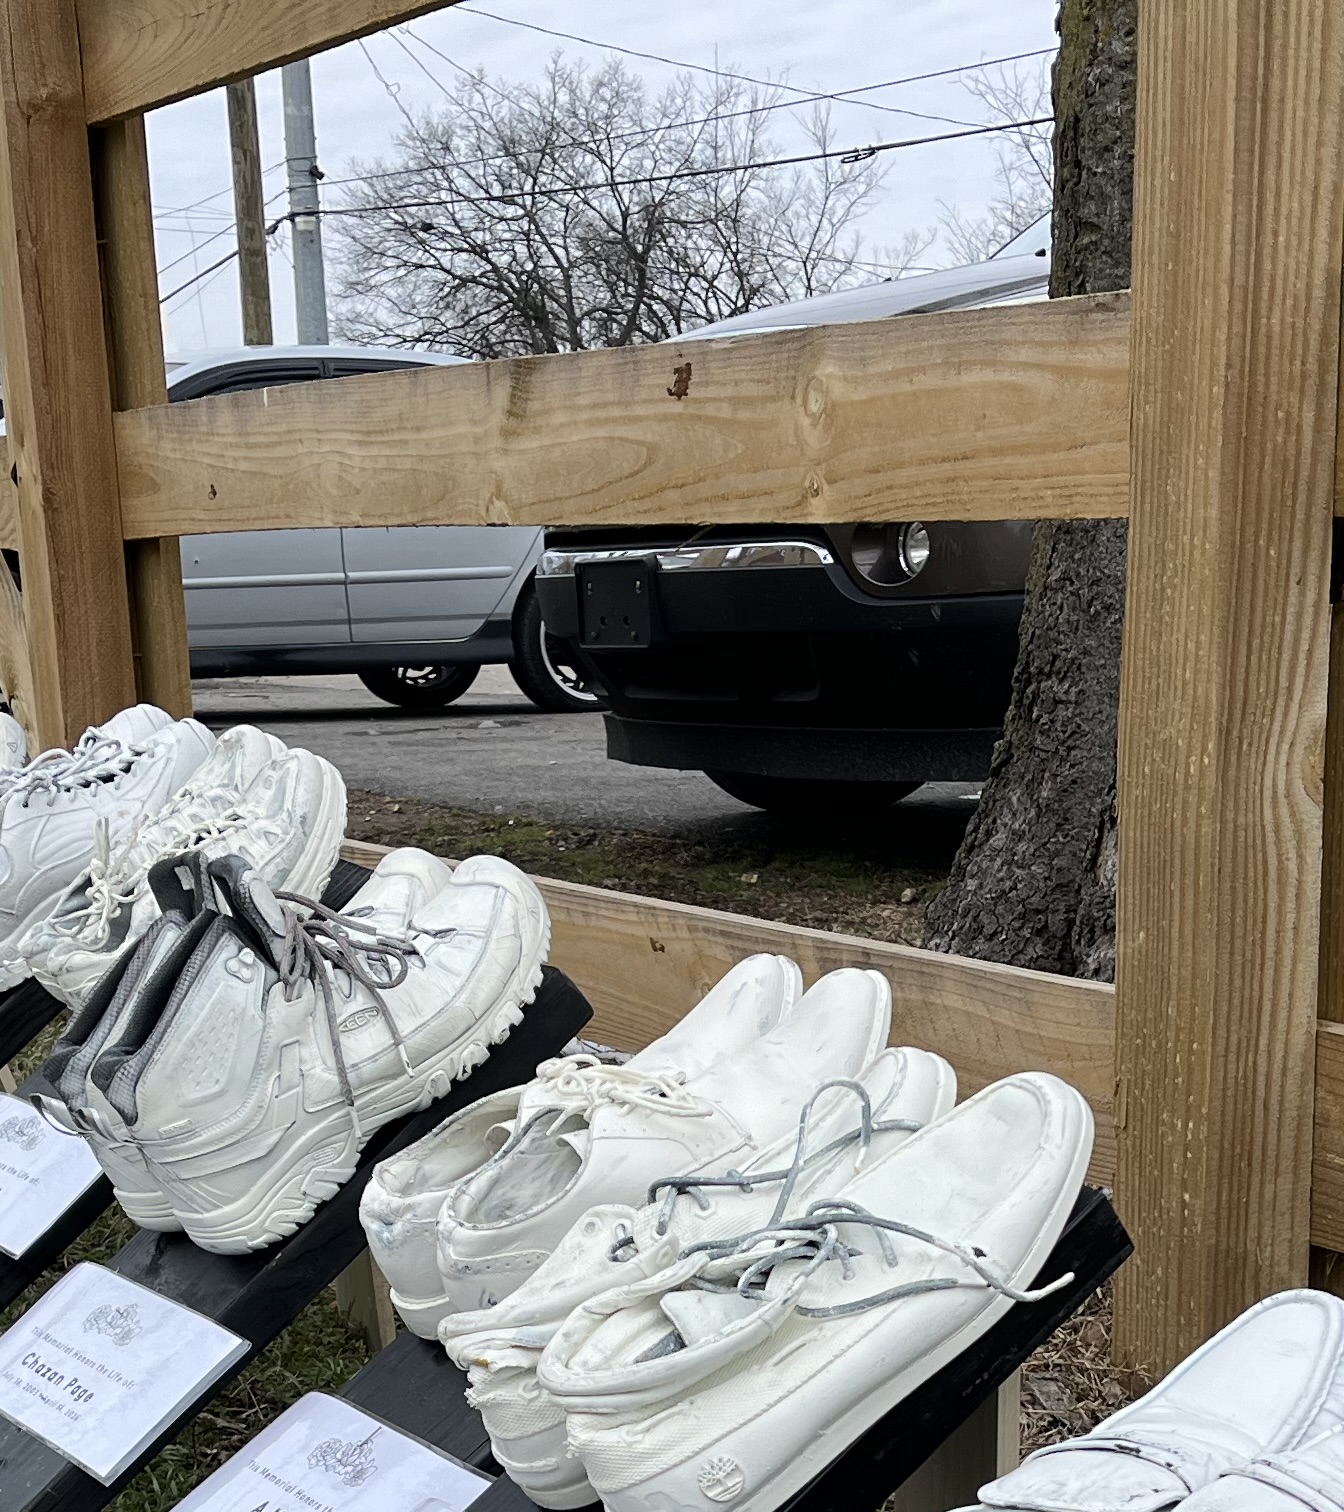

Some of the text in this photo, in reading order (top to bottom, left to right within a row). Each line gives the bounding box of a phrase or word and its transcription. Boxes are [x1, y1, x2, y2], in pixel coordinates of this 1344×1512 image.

[21, 1352, 95, 1403] Chazan Page
[259, 1467, 297, 1494] Memorial
[294, 1488, 322, 1511] Honors
